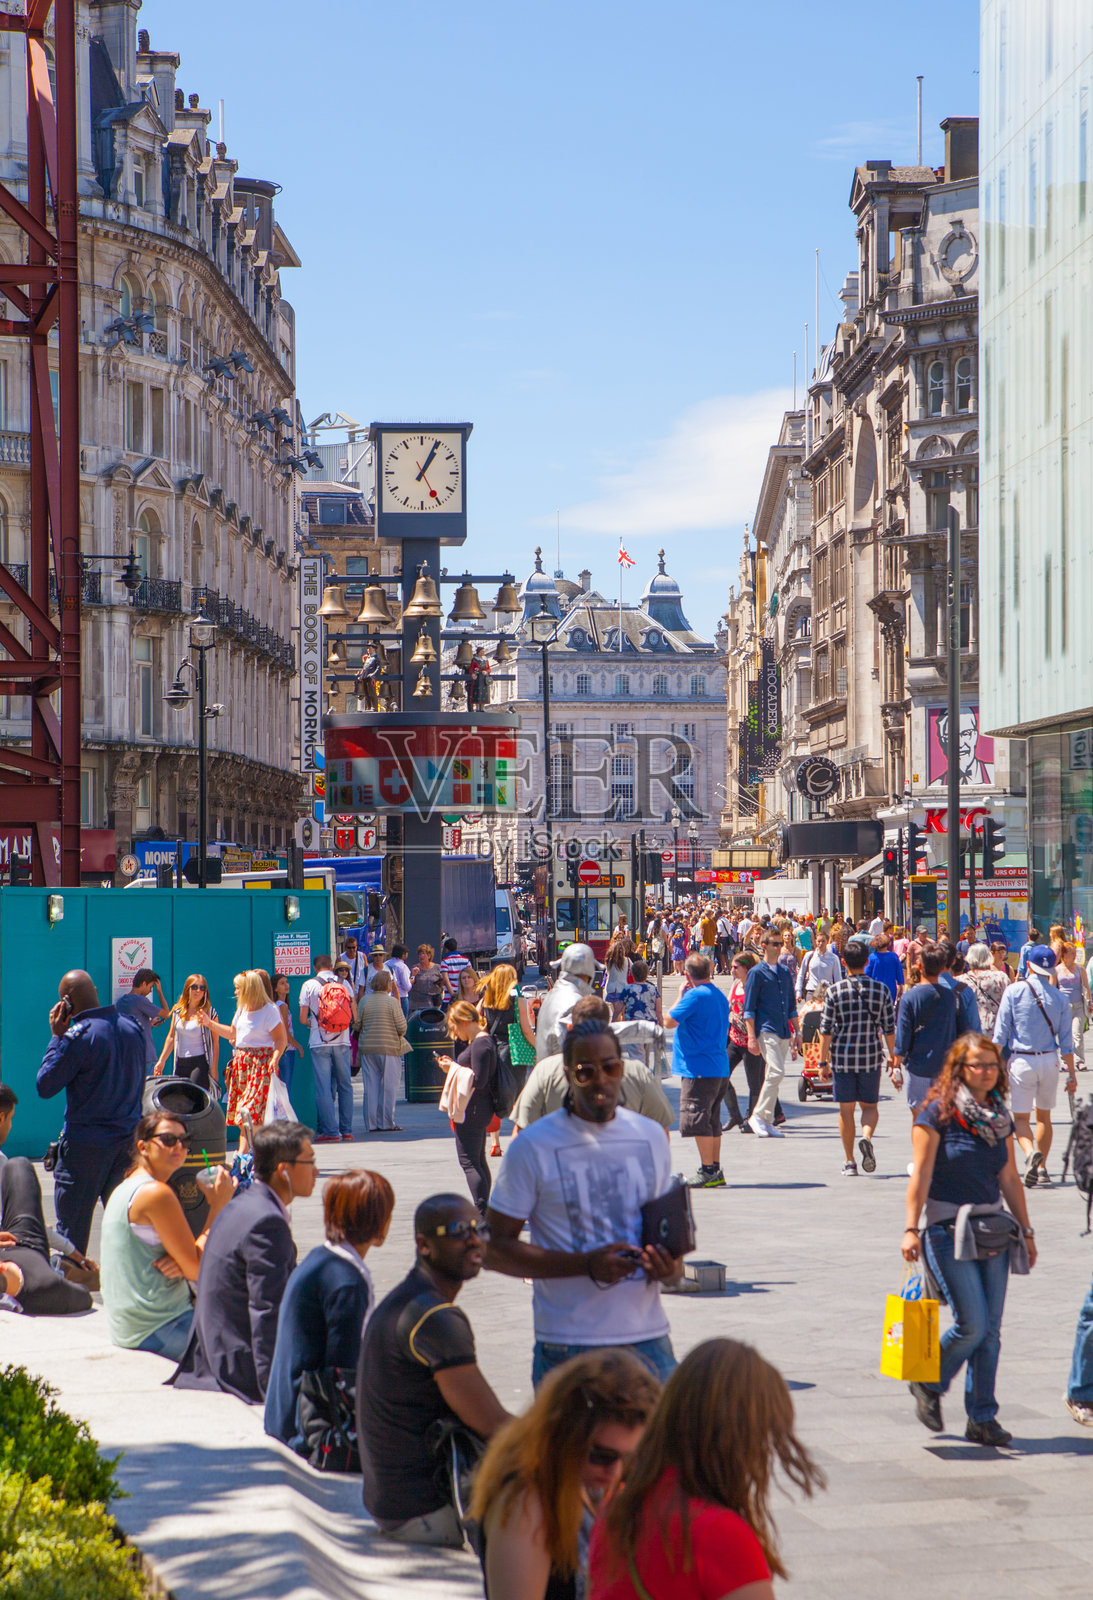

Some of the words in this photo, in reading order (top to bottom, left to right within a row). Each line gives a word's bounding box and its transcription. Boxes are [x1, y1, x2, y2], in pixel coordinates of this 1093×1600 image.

[304, 562, 317, 596] THE
[304, 604, 317, 655] BOOK
[304, 661, 317, 685] OF
[767, 660, 777, 735] TROCADERO
[275, 947, 310, 955] DANGER
[275, 967, 294, 976] KEEP
[295, 967, 310, 975] OUT
